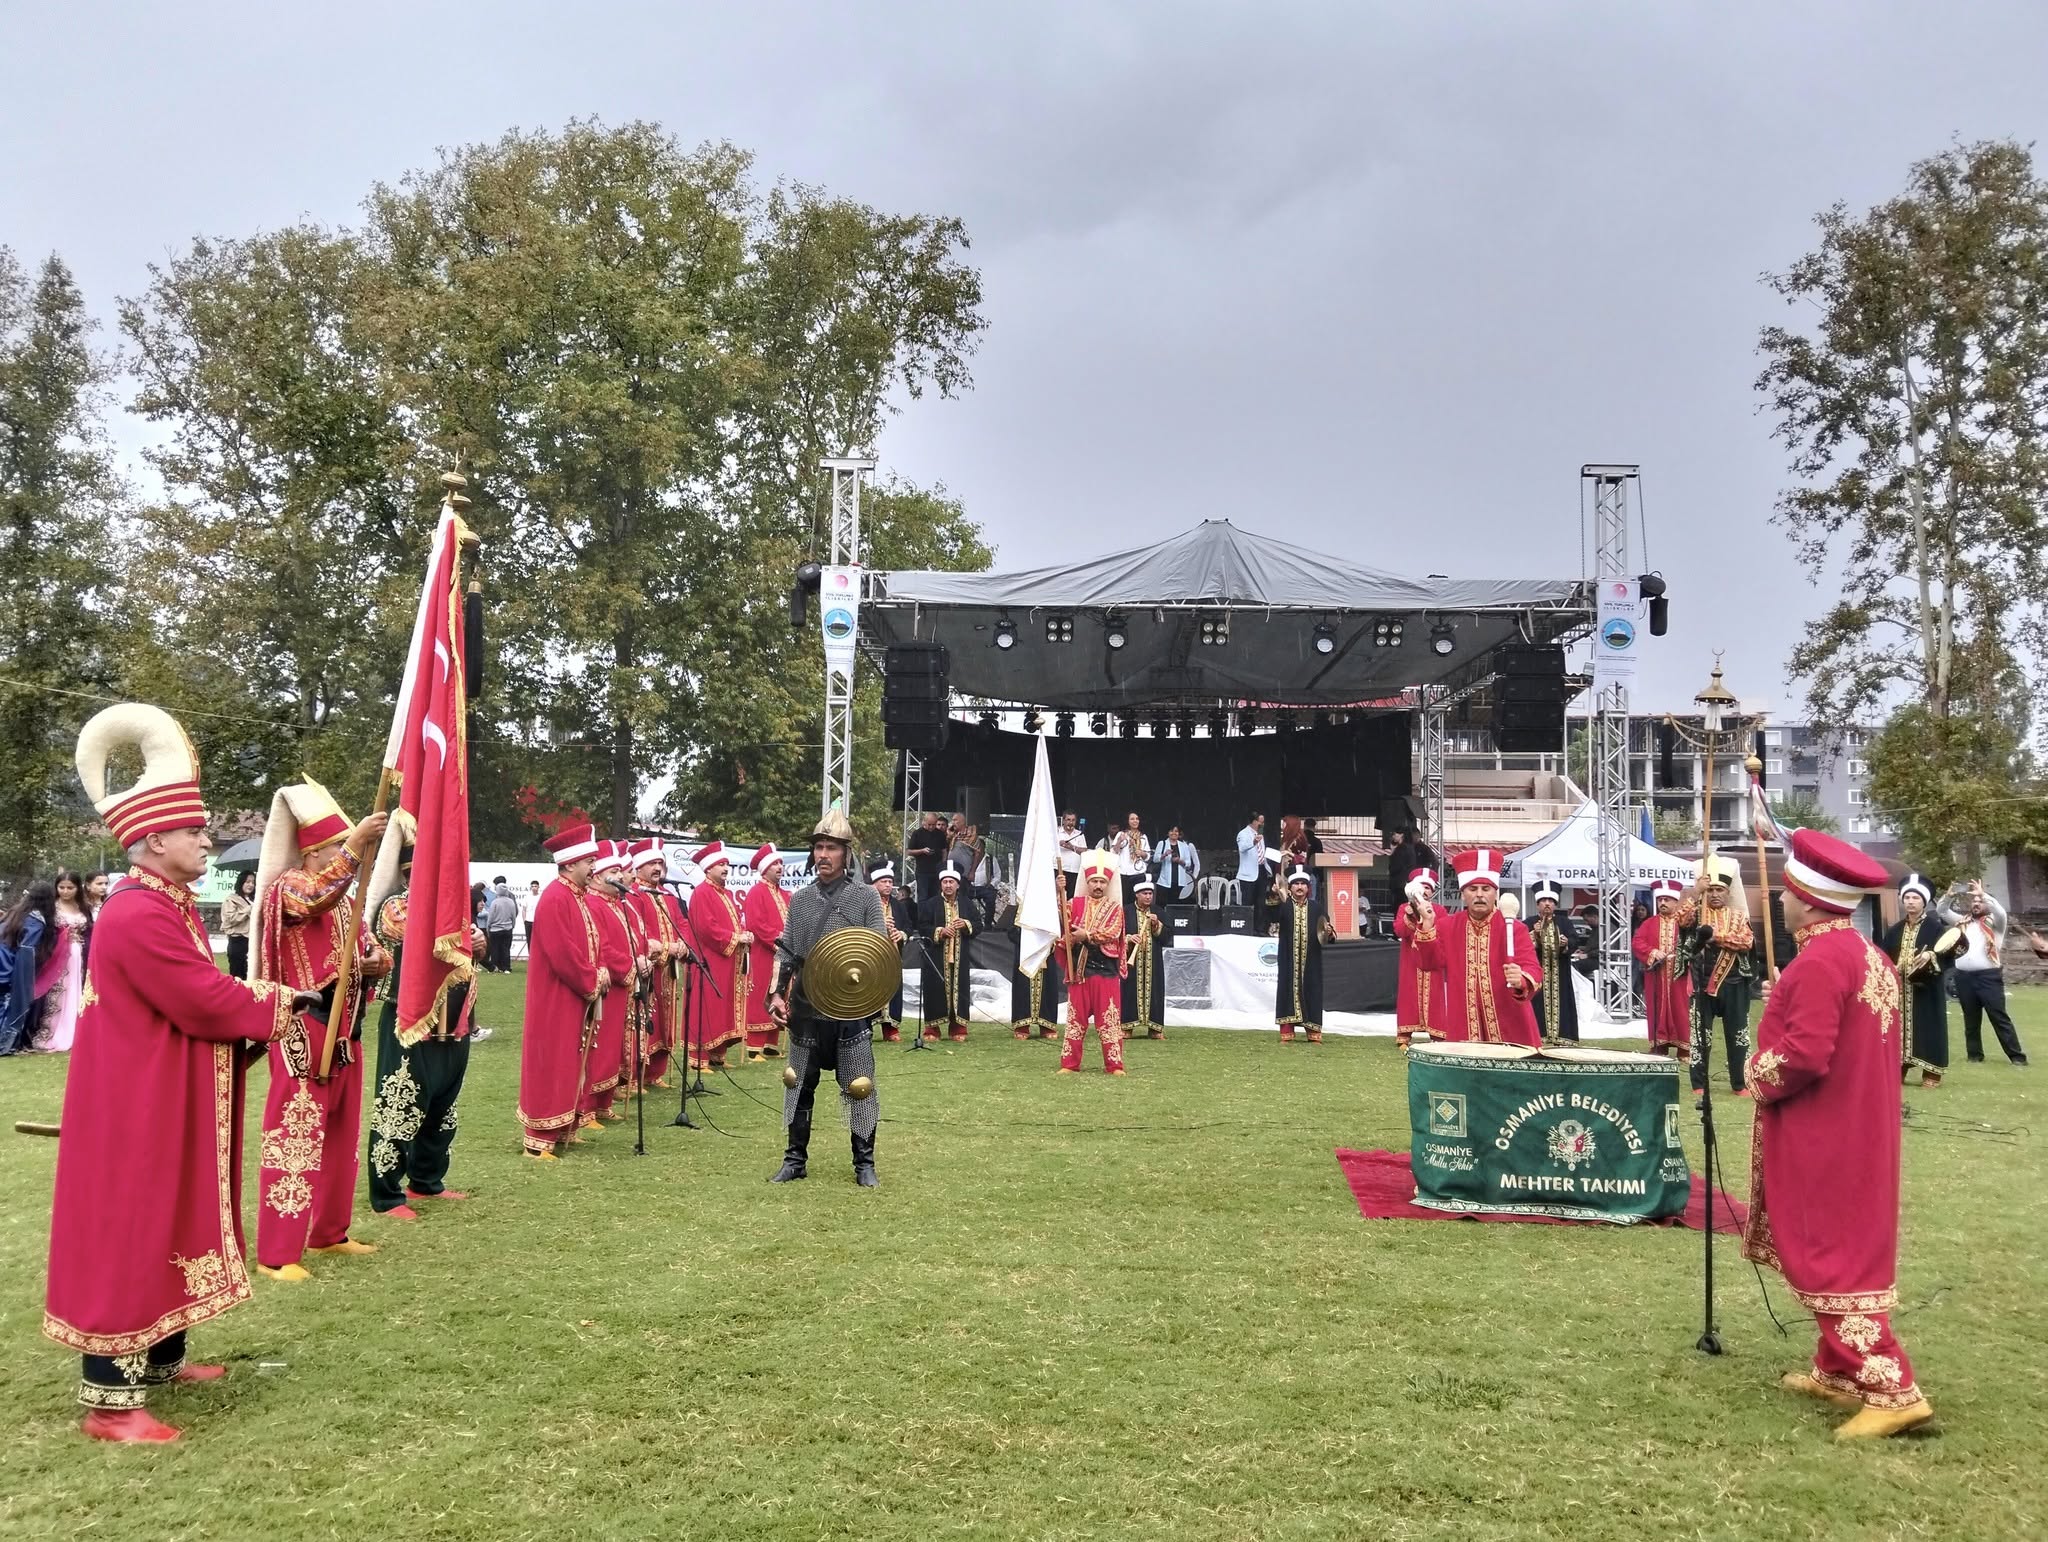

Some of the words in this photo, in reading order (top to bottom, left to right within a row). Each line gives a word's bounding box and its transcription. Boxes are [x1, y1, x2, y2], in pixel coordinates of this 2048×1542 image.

[1495, 1093, 1565, 1150] OSMANİYE
[1571, 1093, 1648, 1155] BELEDİYESİ
[1425, 1142, 1473, 1156] OSMANİYE
[1500, 1173, 1575, 1192] MEHTER
[1580, 1177, 1646, 1195] TAKIMI
